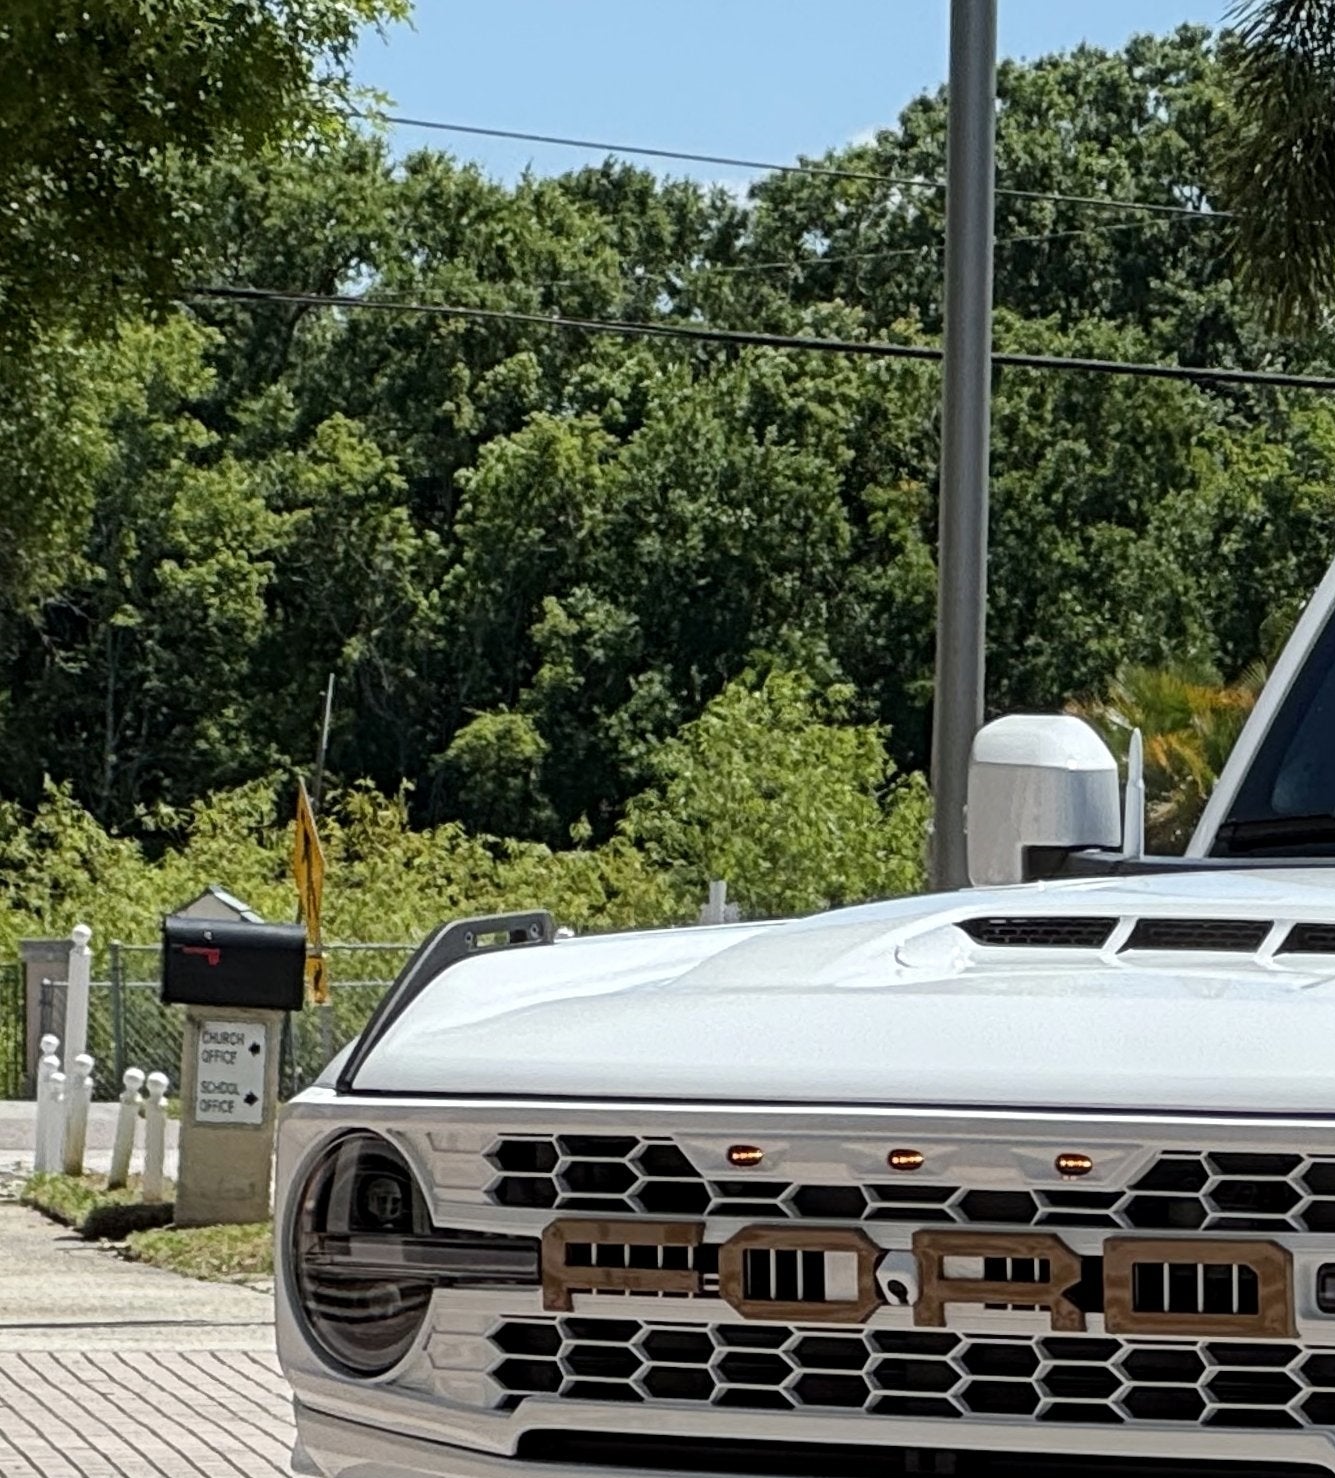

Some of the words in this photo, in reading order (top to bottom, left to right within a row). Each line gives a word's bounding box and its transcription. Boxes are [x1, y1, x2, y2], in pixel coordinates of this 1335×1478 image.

[202, 1030, 245, 1046] CHURCH
[201, 1049, 237, 1065] OFFICE
[200, 1080, 240, 1096] SCHOOL
[200, 1099, 234, 1114] OFFICE
[541, 1218, 1299, 1338] FORD
